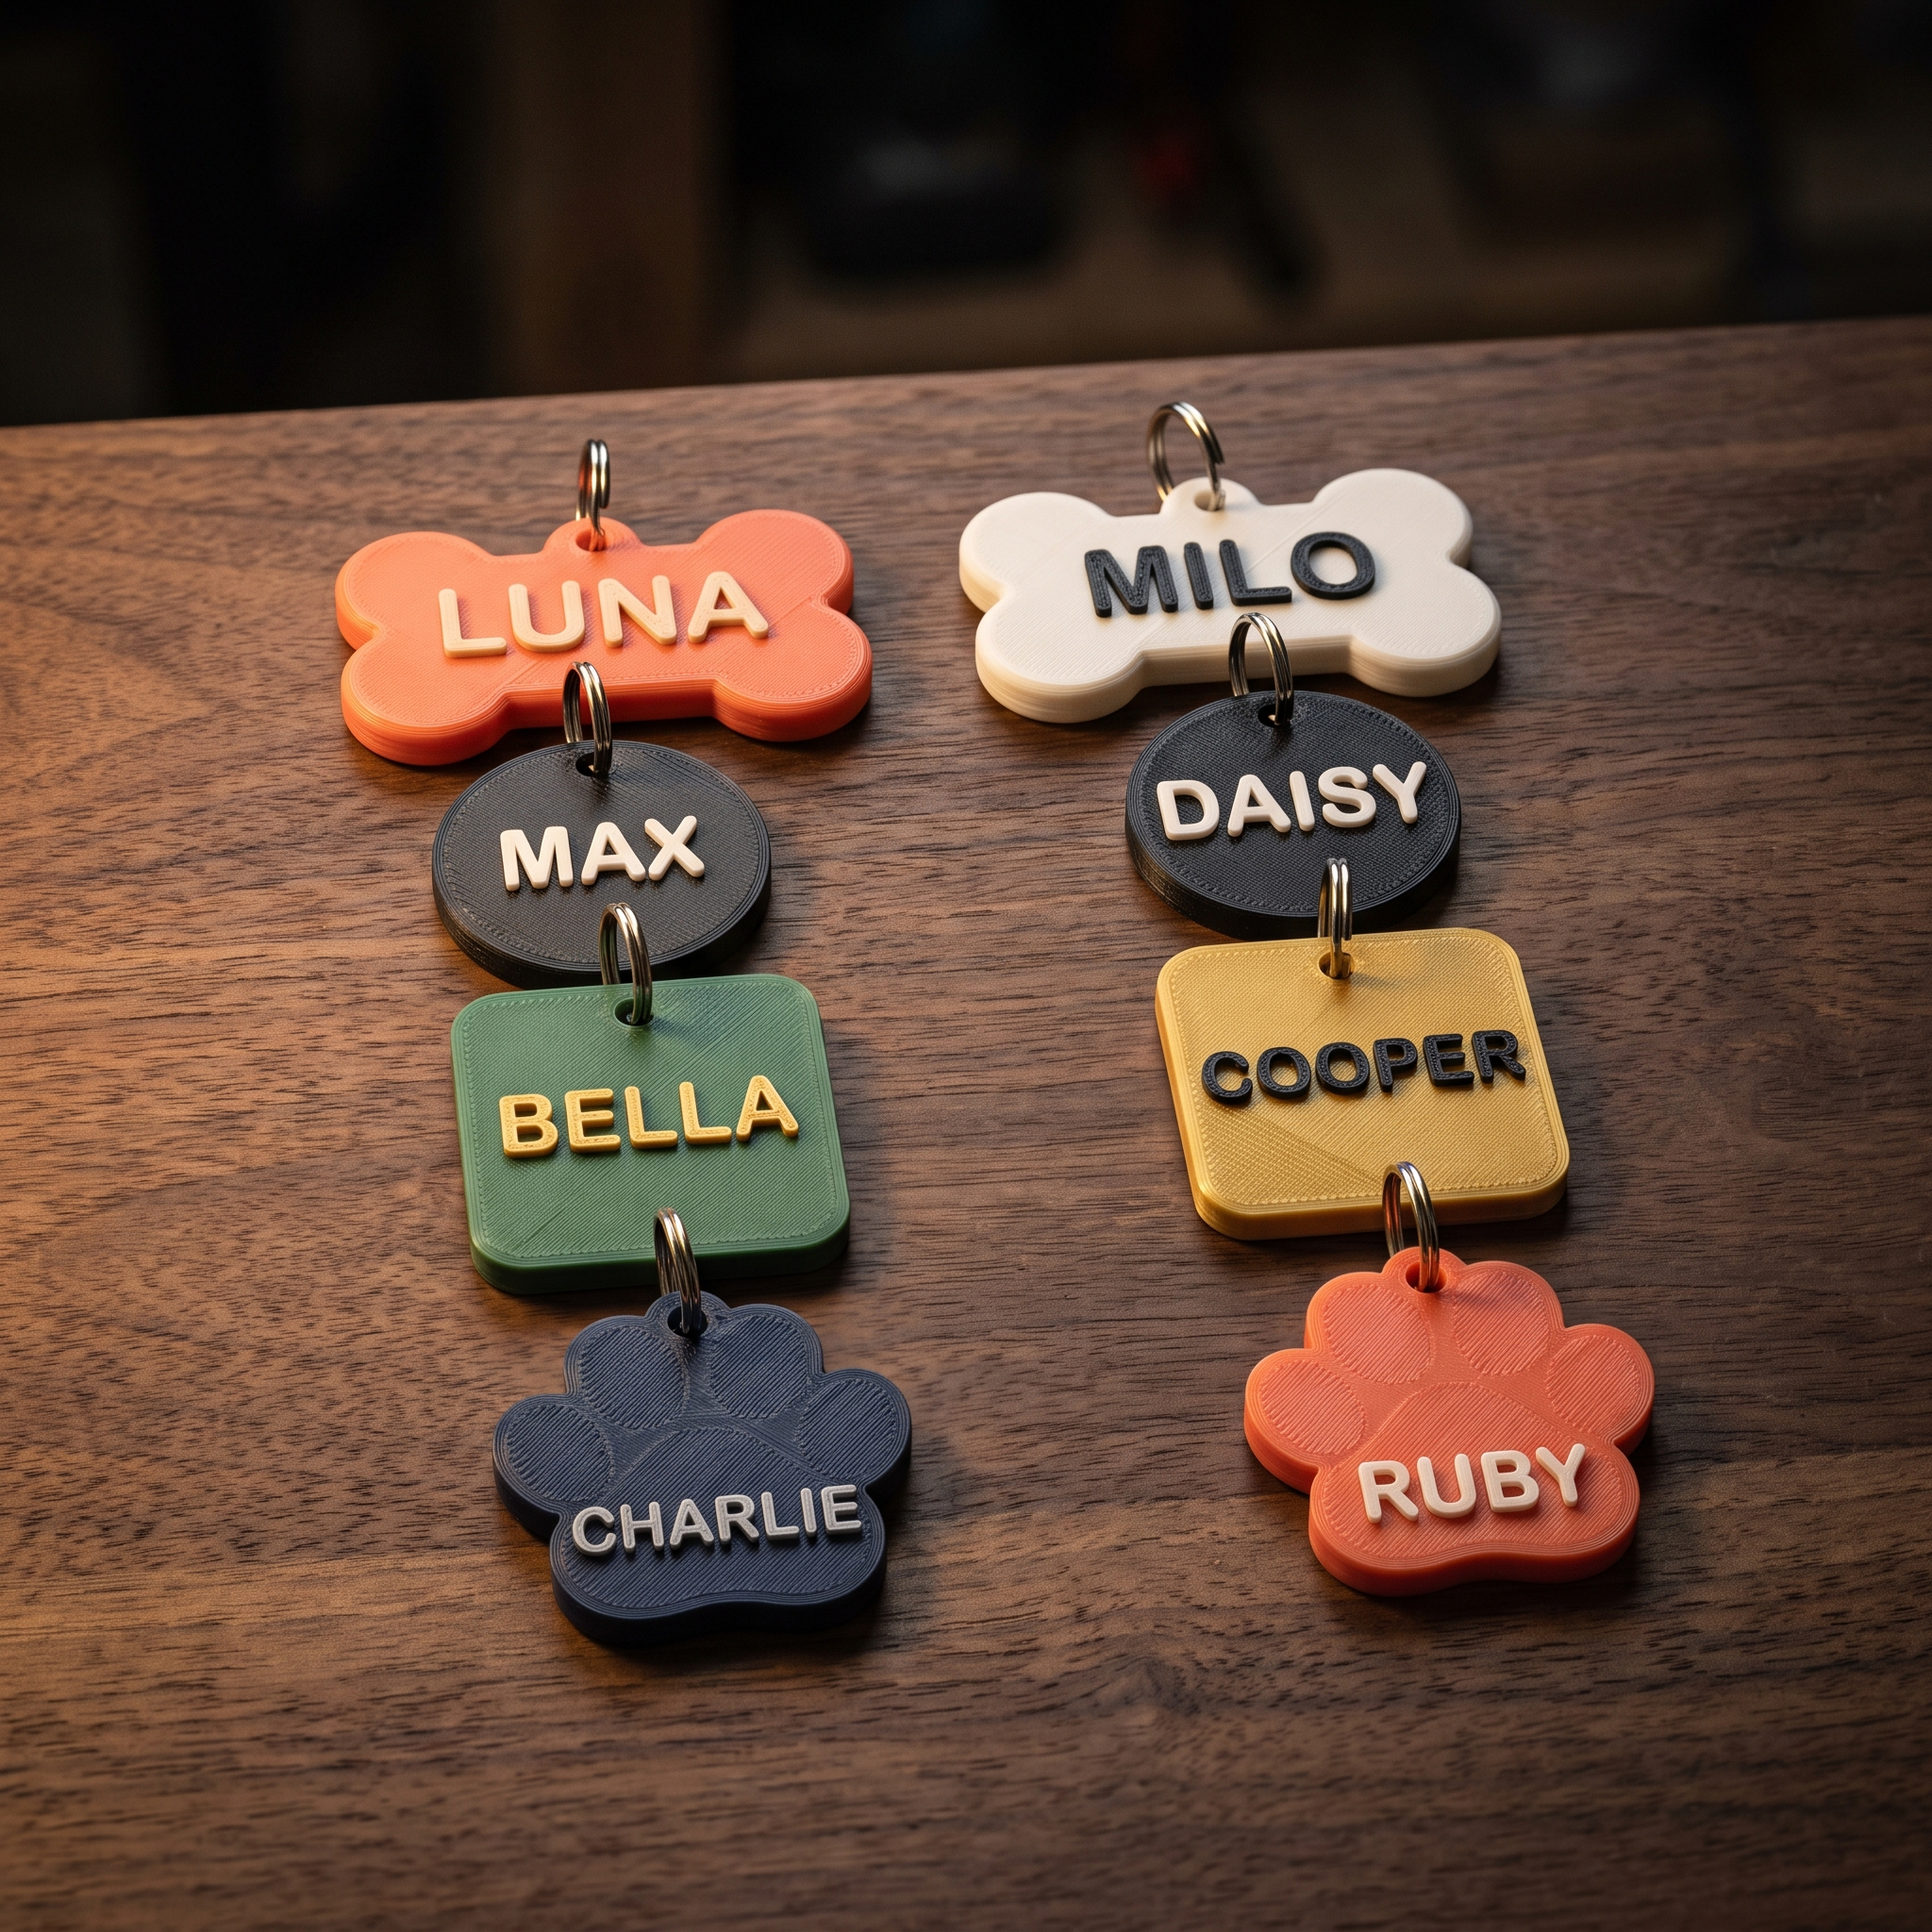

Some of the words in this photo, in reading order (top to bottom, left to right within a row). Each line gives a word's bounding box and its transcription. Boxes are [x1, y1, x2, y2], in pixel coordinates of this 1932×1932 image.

[439, 570, 770, 658] LUNA
[1084, 531, 1376, 617] MILO
[1156, 759, 1426, 841] DAISY
[499, 815, 705, 890] MAX
[1200, 1029, 1526, 1105] COOPER
[499, 1074, 799, 1158] BELLA
[571, 1484, 861, 1556] CHARLIE
[1357, 1442, 1585, 1524] RUBY
